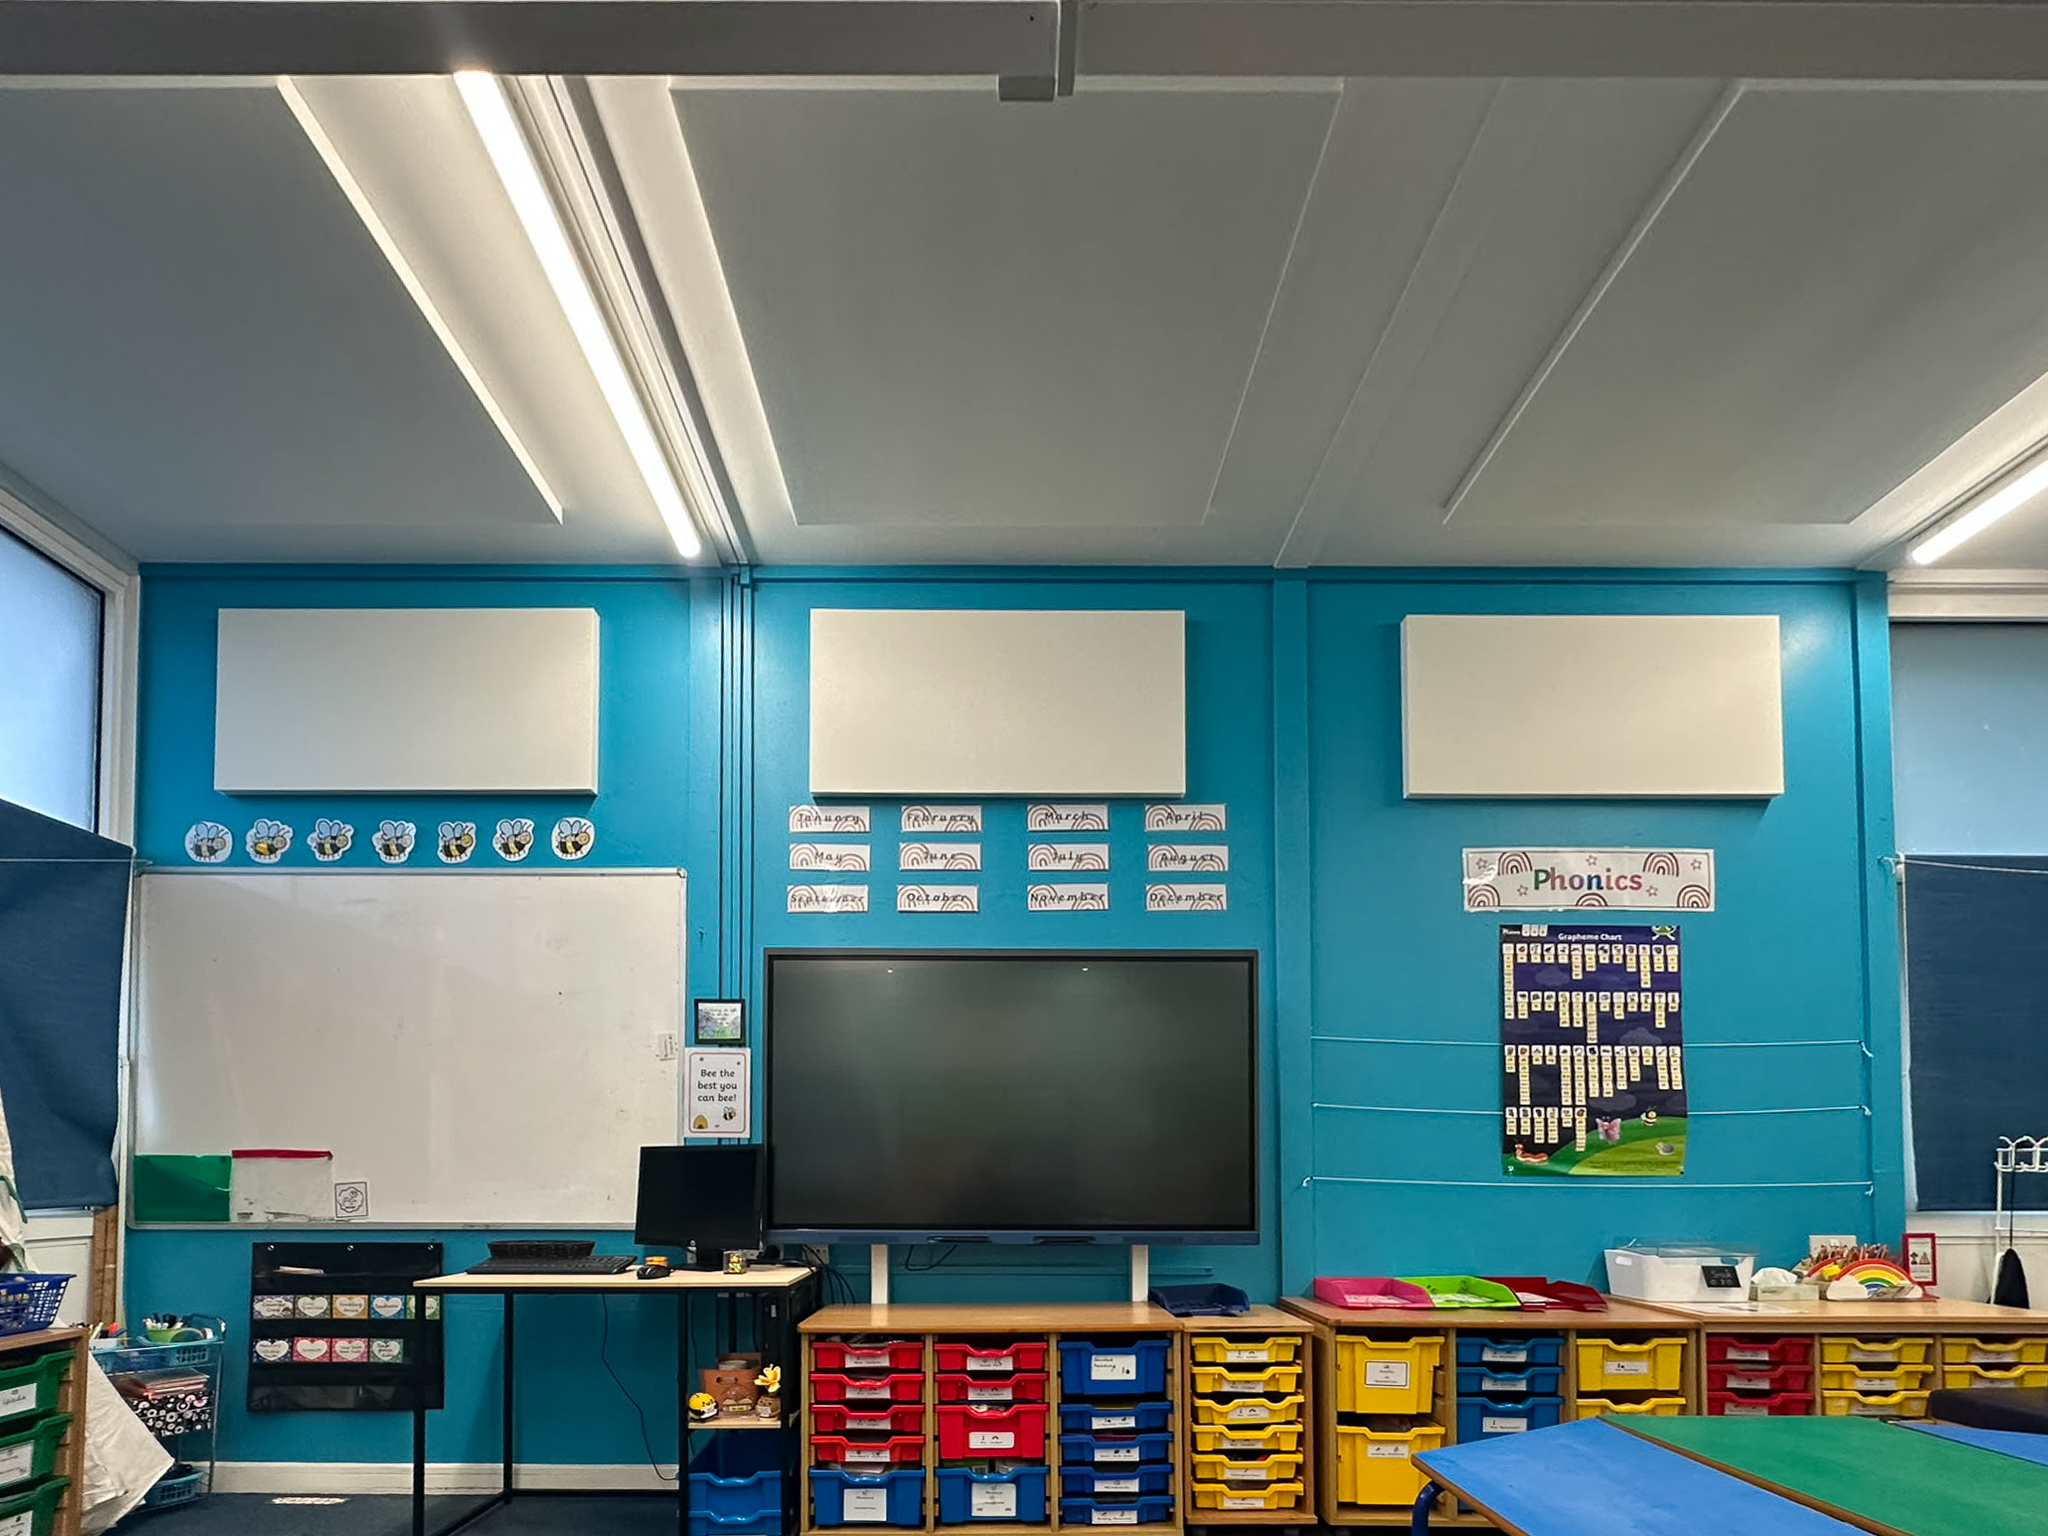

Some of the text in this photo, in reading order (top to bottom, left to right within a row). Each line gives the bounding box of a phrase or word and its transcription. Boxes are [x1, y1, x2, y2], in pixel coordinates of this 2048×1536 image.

[798, 813, 860, 824] January
[907, 812, 975, 824] February
[1045, 811, 1089, 821] March
[1166, 812, 1203, 824] April
[815, 851, 844, 864] May
[923, 850, 955, 861] June
[1053, 851, 1083, 864] July
[1160, 852, 1215, 865] August
[1534, 867, 1643, 891] Phonics
[907, 892, 966, 902] October
[1030, 891, 1104, 902] November
[1151, 891, 1223, 902] December
[1558, 932, 1622, 942] Grapheme Chart
[701, 1068, 735, 1078] Bee the
[698, 1081, 737, 1092] best you
[698, 1093, 737, 1102] can bee!
